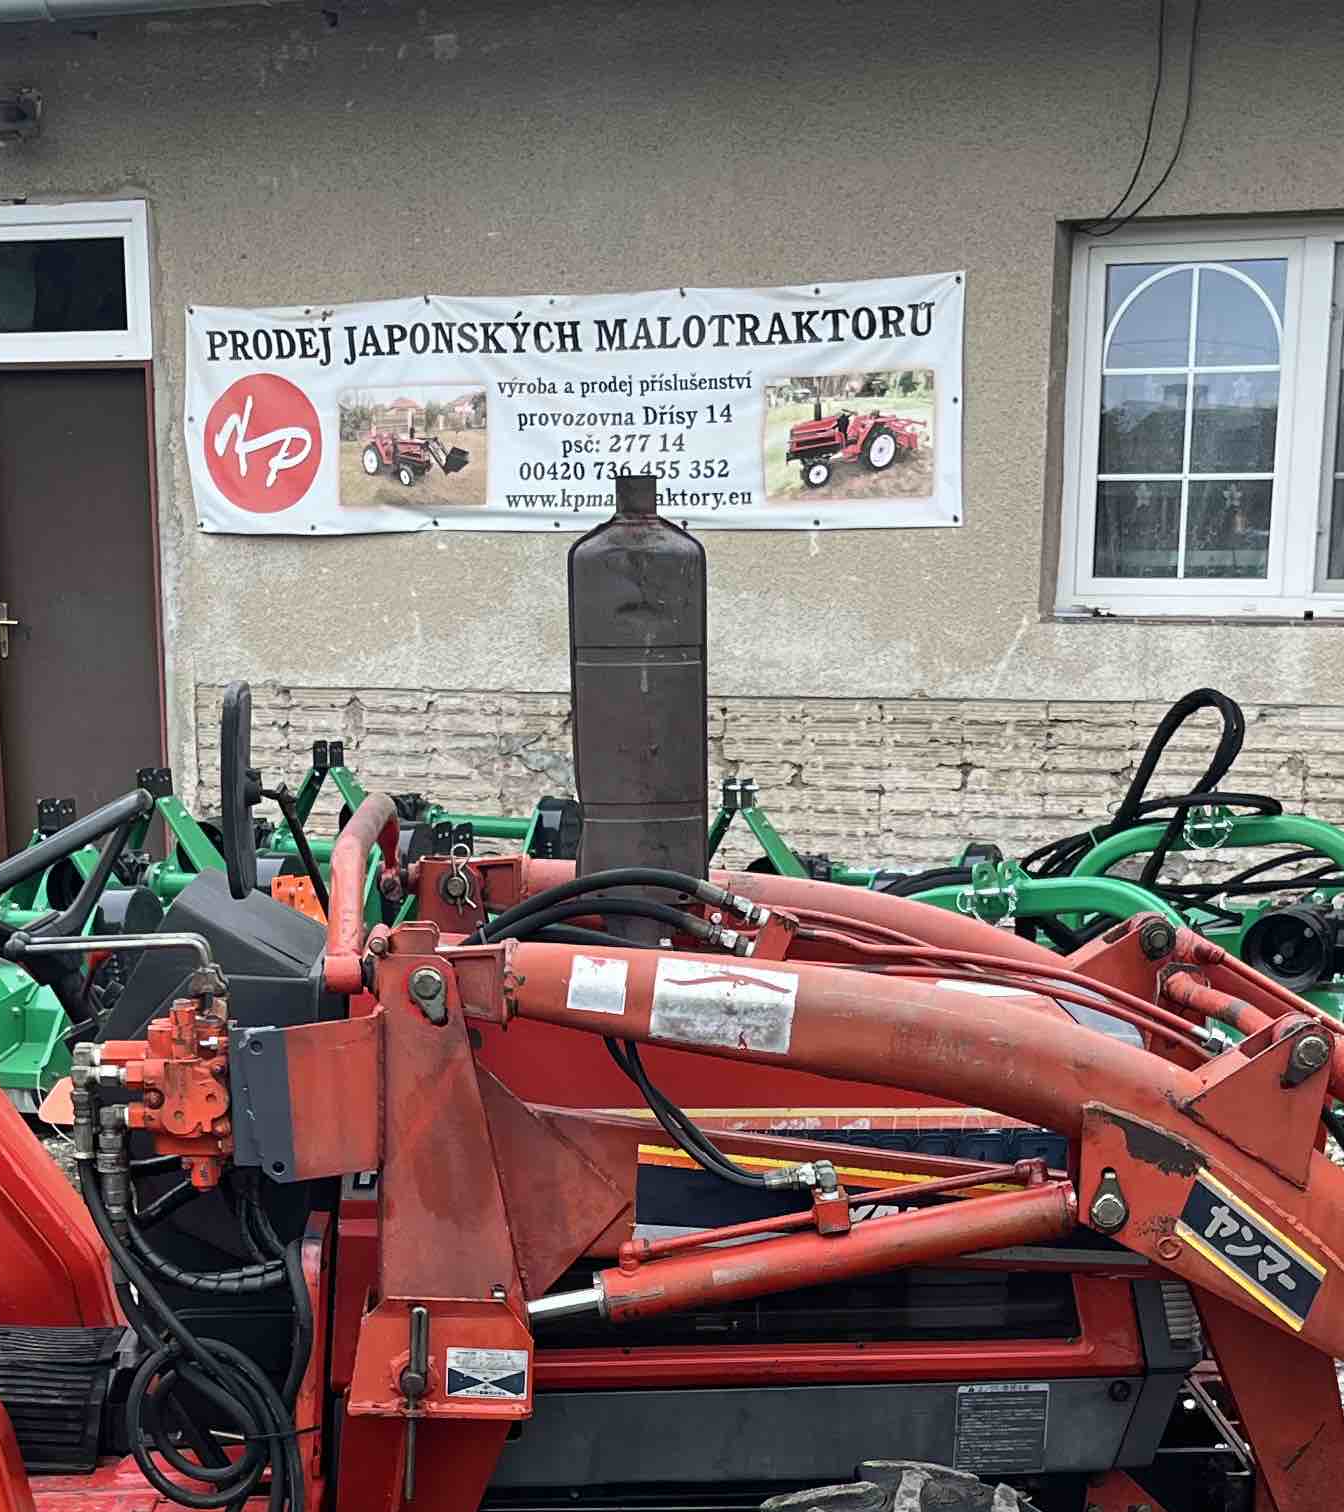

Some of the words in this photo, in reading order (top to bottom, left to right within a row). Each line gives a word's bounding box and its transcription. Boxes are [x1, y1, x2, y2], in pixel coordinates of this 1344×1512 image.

[206, 326, 332, 366] PRODEJ
[344, 311, 582, 365] JAPONSKÝCH
[497, 377, 558, 397] výroba
[564, 382, 575, 394] a
[580, 375, 633, 397] prodej
[639, 371, 753, 396] příslušenství
[516, 410, 636, 431] provozovna
[642, 405, 698, 429] Dřísy
[706, 404, 734, 424] 14
[562, 434, 601, 457] psč:
[609, 434, 650, 453] 277
[660, 433, 686, 453] 14
[519, 461, 585, 480] 00420
[593, 460, 632, 480] 736
[640, 459, 681, 479] 455
[689, 459, 730, 479] 352
[506, 487, 753, 512] www.kpmaaktory.eu
[1204, 1205, 1297, 1290] ヤンマー
